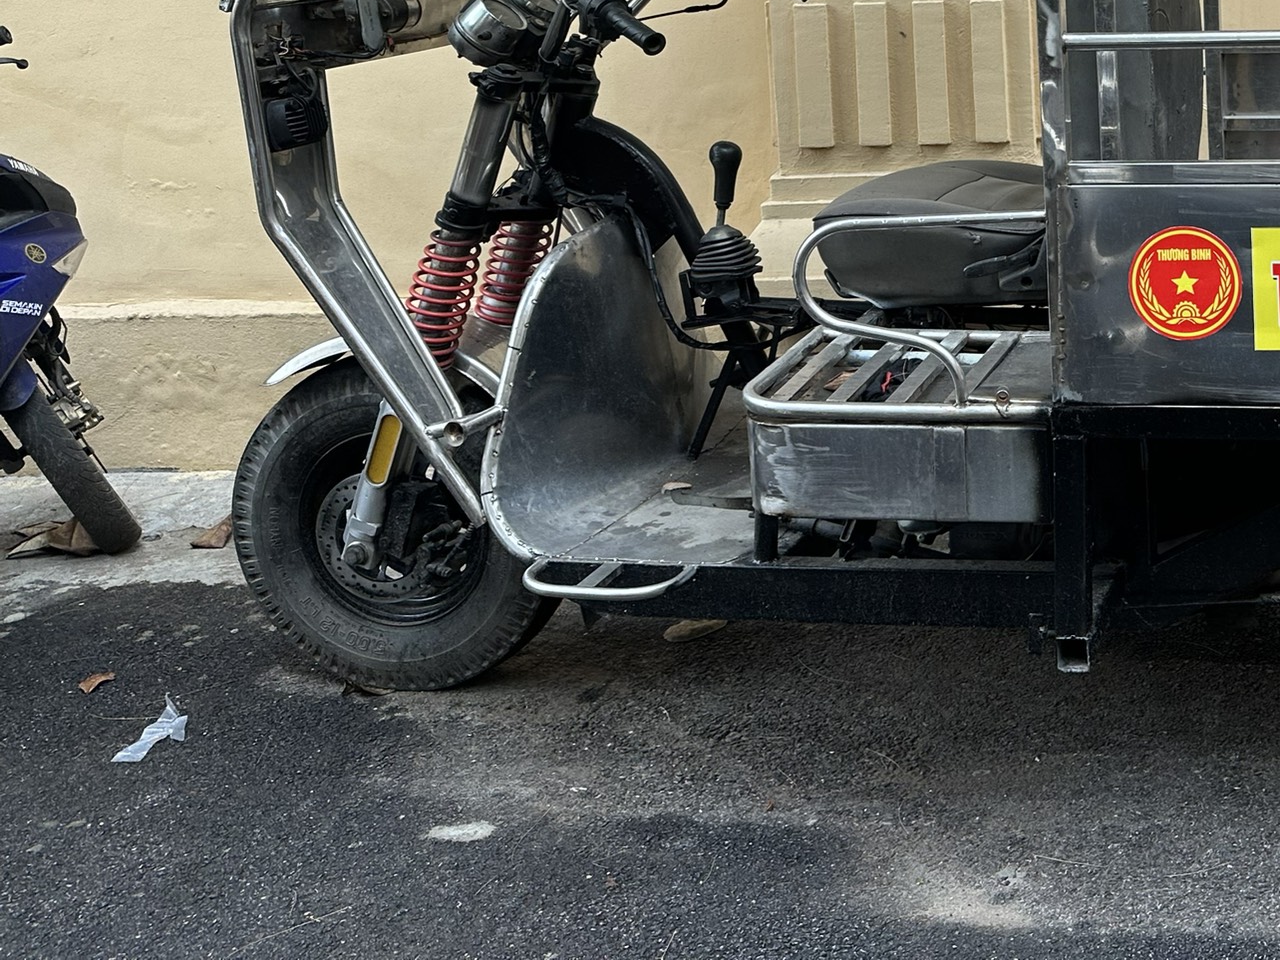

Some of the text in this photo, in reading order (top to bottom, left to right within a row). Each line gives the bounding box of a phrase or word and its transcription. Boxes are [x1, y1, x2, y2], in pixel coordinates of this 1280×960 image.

[8, 158, 39, 177] YAMAHA
[1156, 248, 1211, 261] THƯƠNG BINH
[2, 300, 43, 311] SEMAKIN
[11, 307, 41, 317] DEPAN
